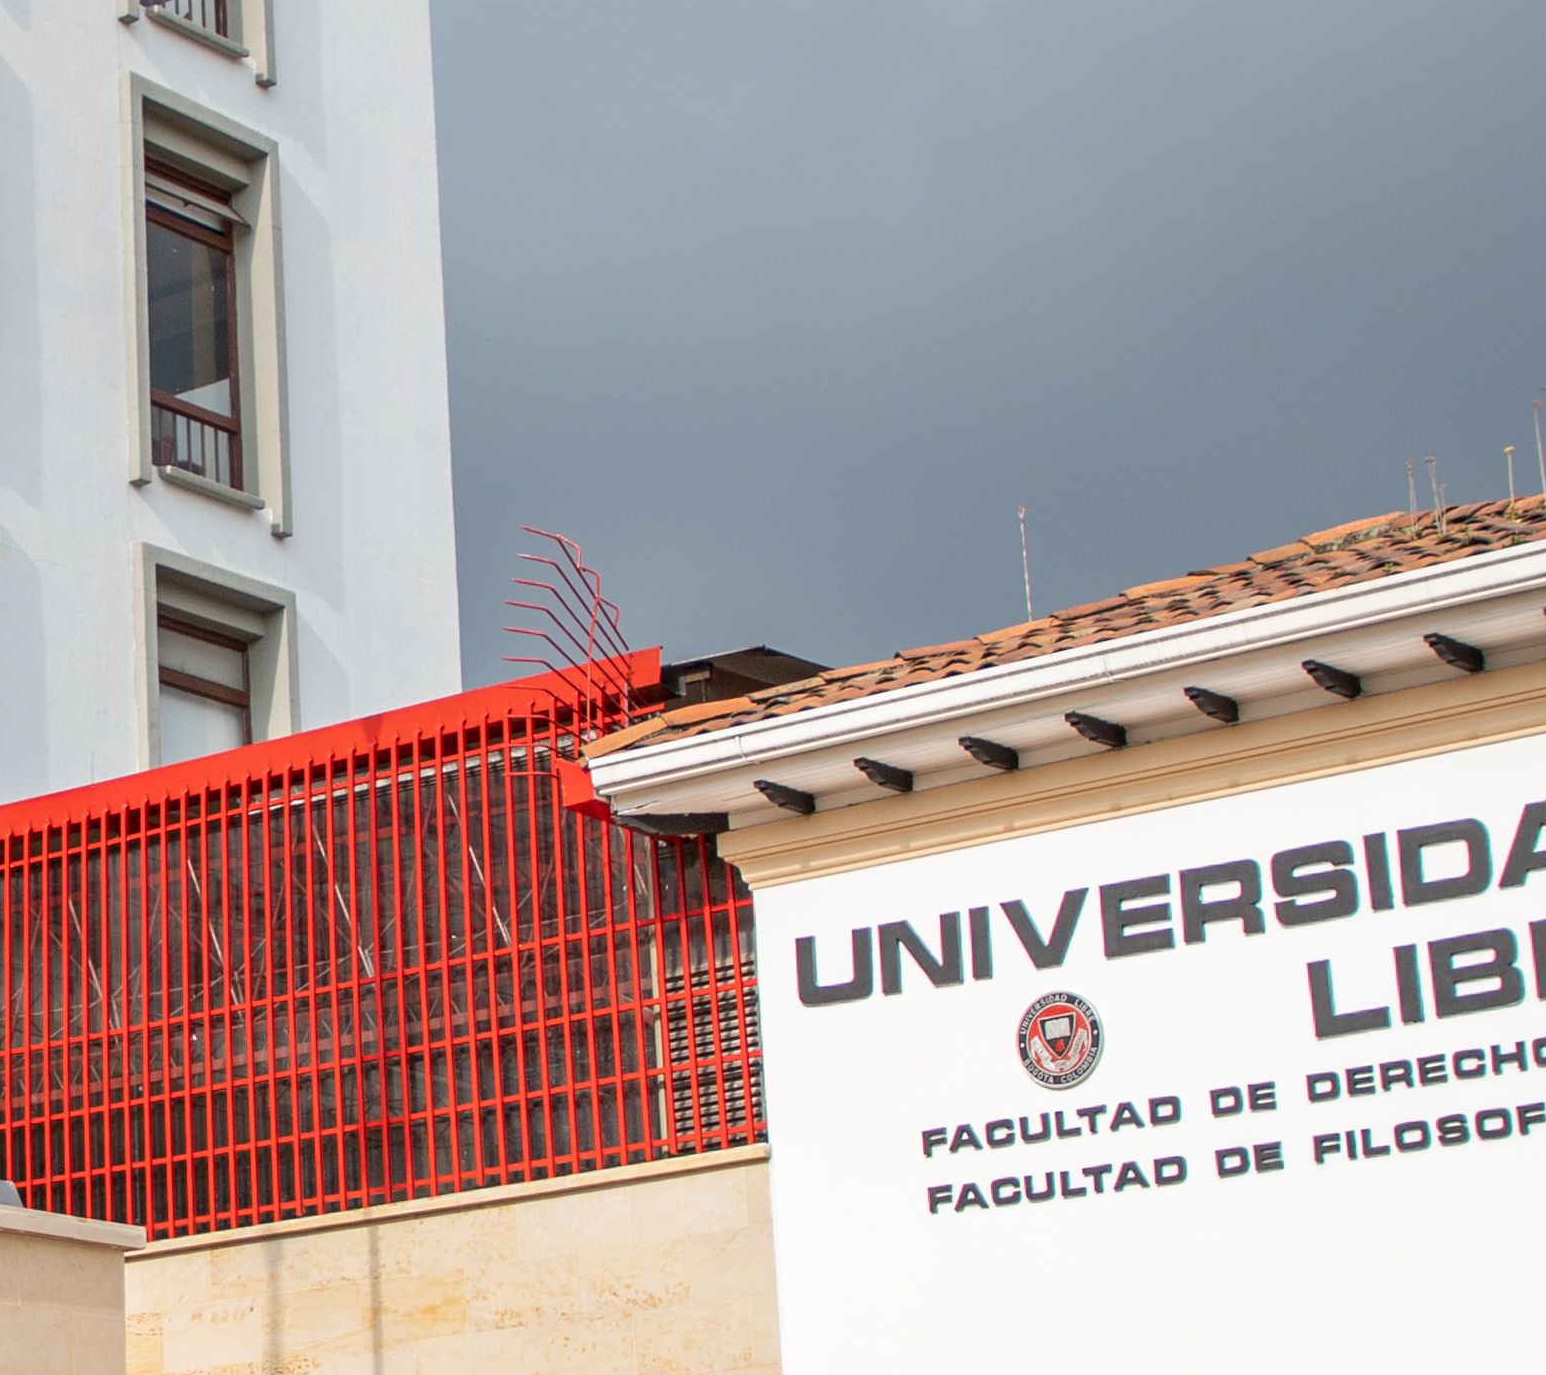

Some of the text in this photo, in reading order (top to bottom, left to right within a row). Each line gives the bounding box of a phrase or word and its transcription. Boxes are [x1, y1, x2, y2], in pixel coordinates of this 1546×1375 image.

[1020, 994, 1096, 1035] UNIVERSIDAD LIBRE
[1060, 1046, 1098, 1084] COLOMBIA
[921, 1095, 1182, 1158] FACULTAD
[1209, 1081, 1277, 1118] DE
[927, 1155, 1187, 1216] FACULTAD
[1214, 1141, 1285, 1179] DE
